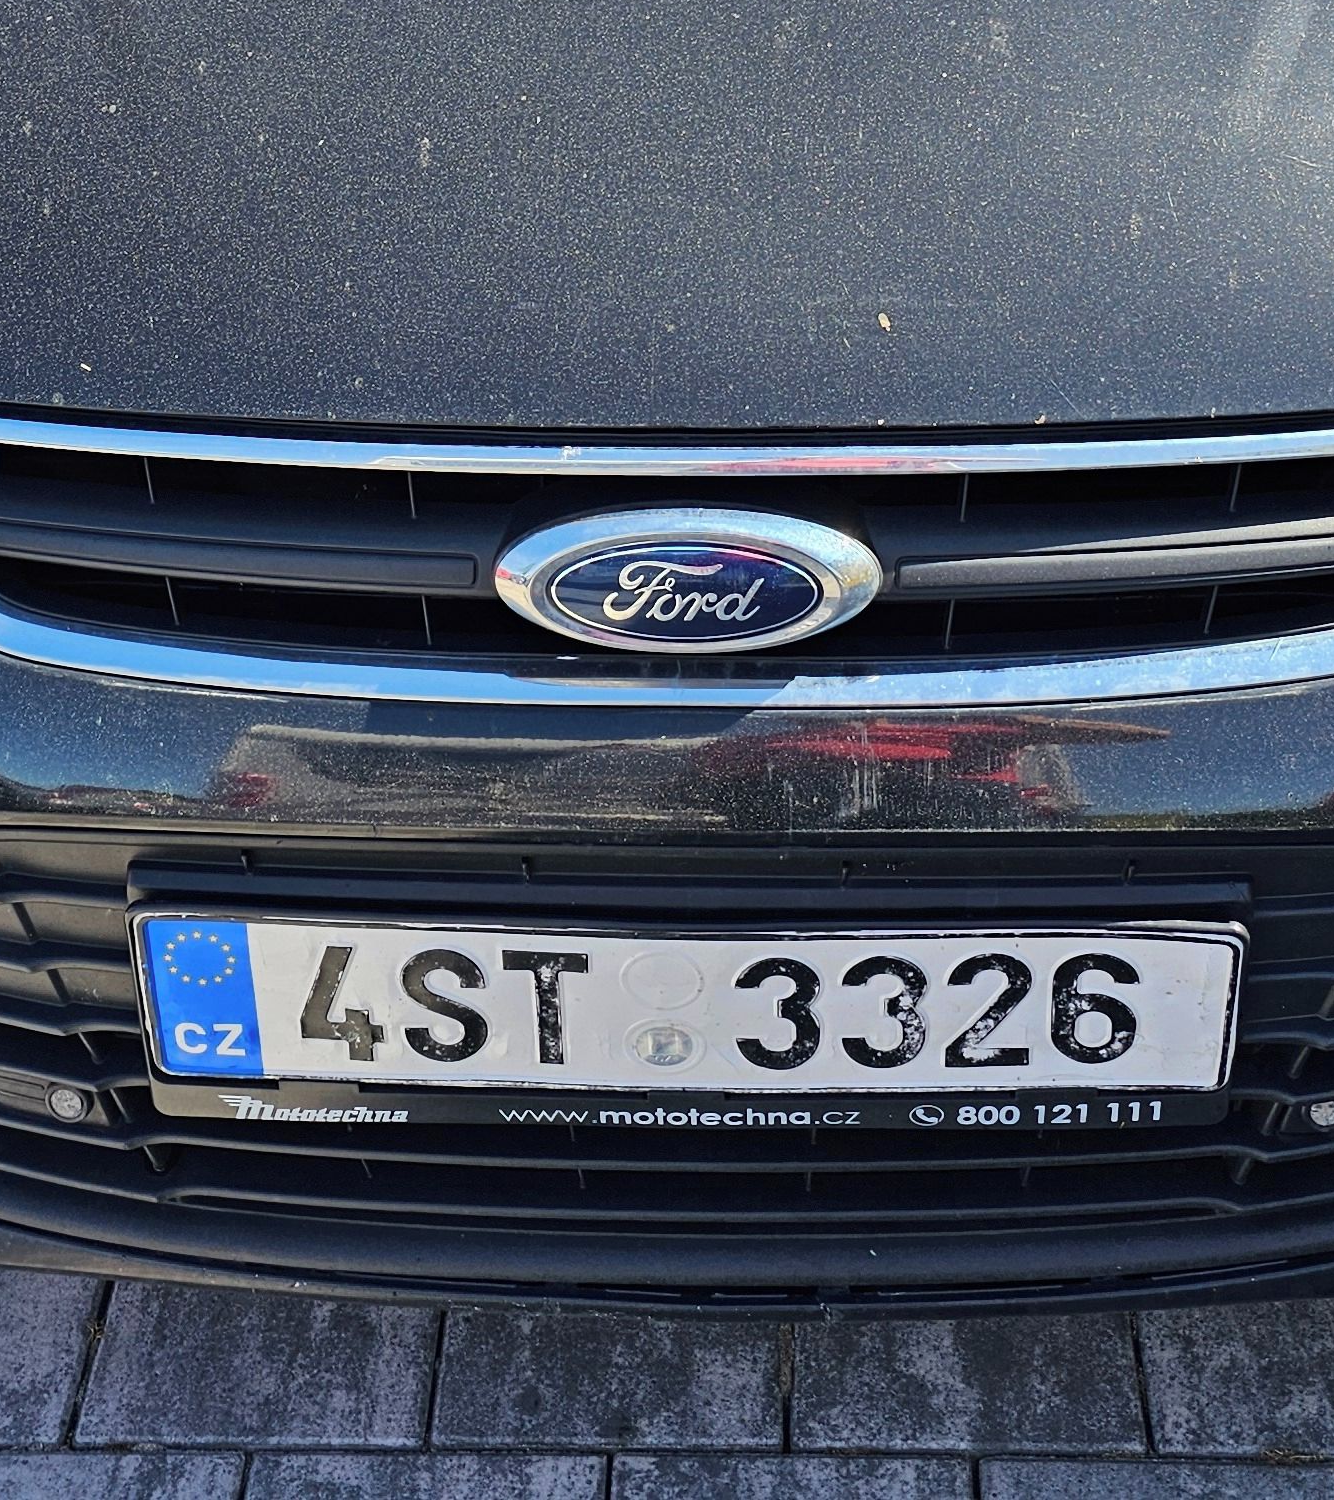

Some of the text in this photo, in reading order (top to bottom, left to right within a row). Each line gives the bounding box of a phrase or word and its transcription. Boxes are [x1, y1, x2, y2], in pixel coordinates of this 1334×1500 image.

[602, 560, 765, 622] Ford
[299, 946, 1142, 1069] 4ST 3326
[174, 1022, 246, 1056] CZ
[218, 1094, 409, 1122] Mototechna
[498, 1107, 861, 1126] www.mototechna.cz
[956, 1101, 1161, 1125] 800 121 111
